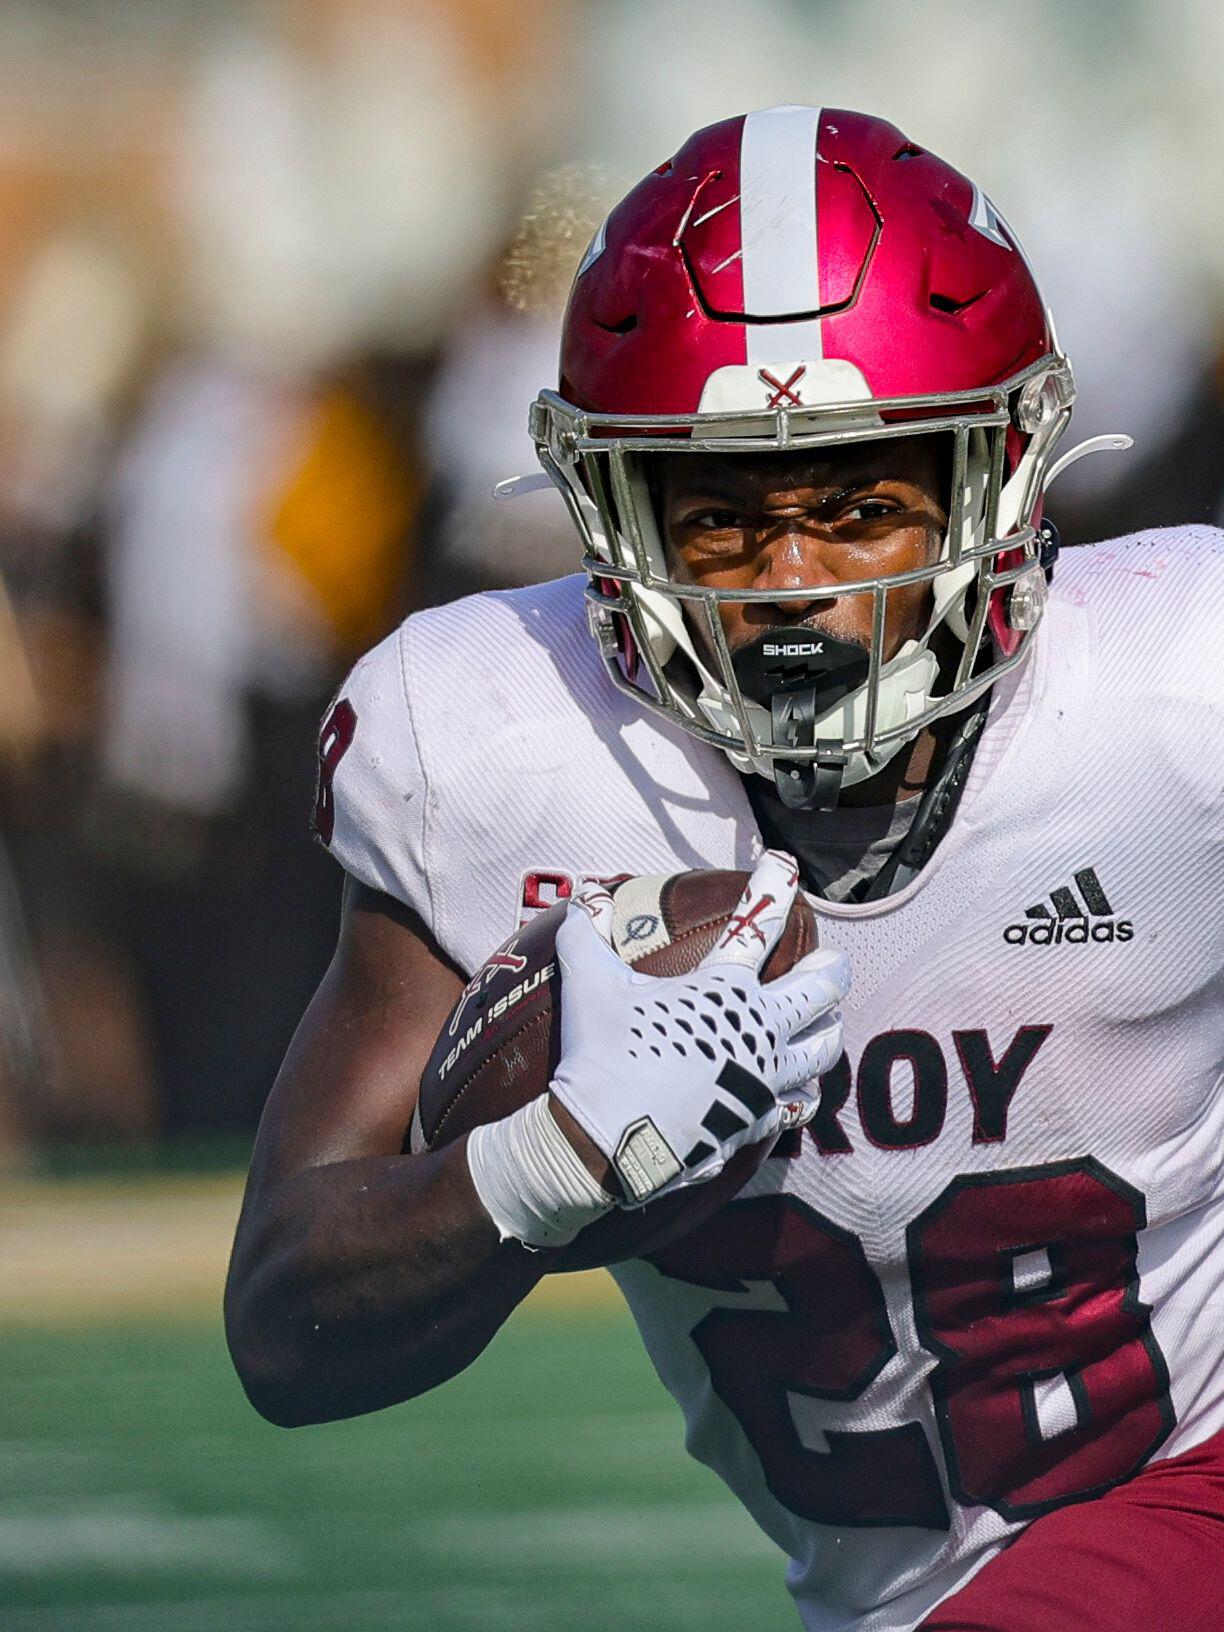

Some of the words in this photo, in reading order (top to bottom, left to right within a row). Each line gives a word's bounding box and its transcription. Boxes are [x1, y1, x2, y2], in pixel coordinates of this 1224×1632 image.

[763, 642, 824, 656] SHOCK
[1003, 915, 1134, 945] adidas
[438, 1017, 483, 1080] TEAM
[768, 1024, 1053, 1158] ROY
[642, 1154, 1177, 1529] 28
